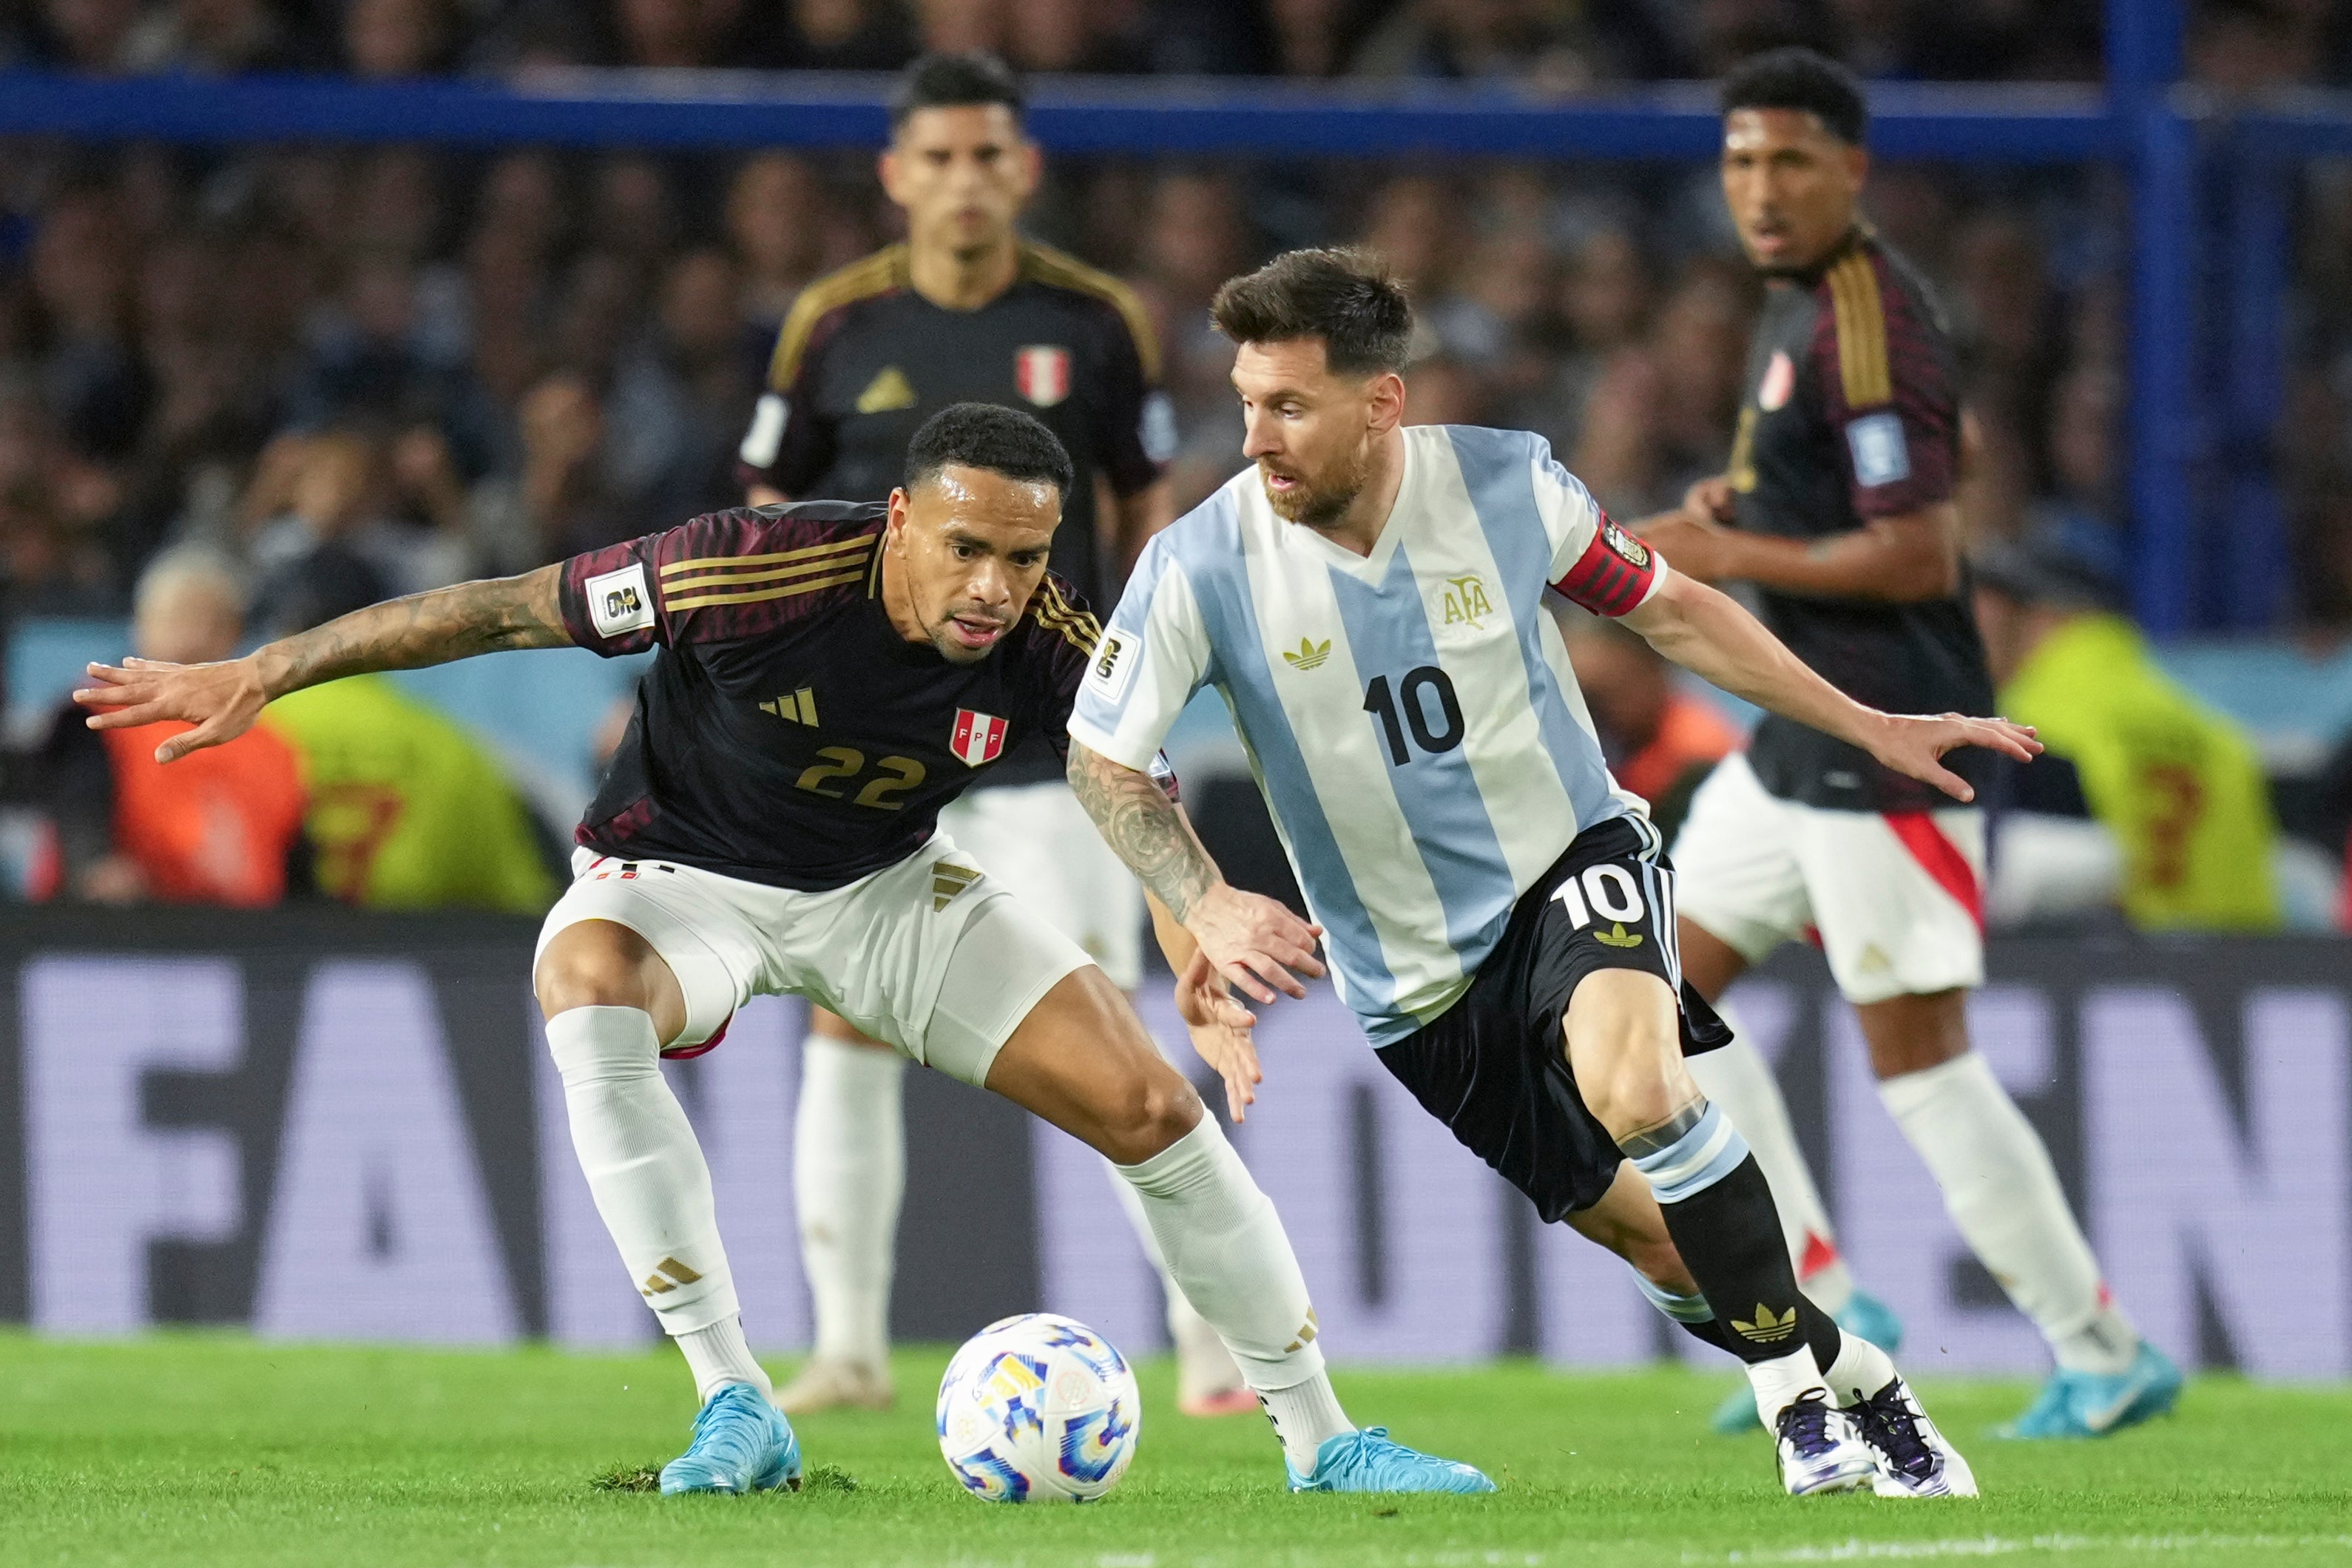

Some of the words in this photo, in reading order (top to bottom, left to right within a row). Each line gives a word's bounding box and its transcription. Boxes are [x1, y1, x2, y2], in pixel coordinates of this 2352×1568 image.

[1444, 575, 1493, 630] AFA
[1363, 666, 1464, 767] 10
[793, 746, 926, 811] 22
[1550, 863, 1644, 930] 10
